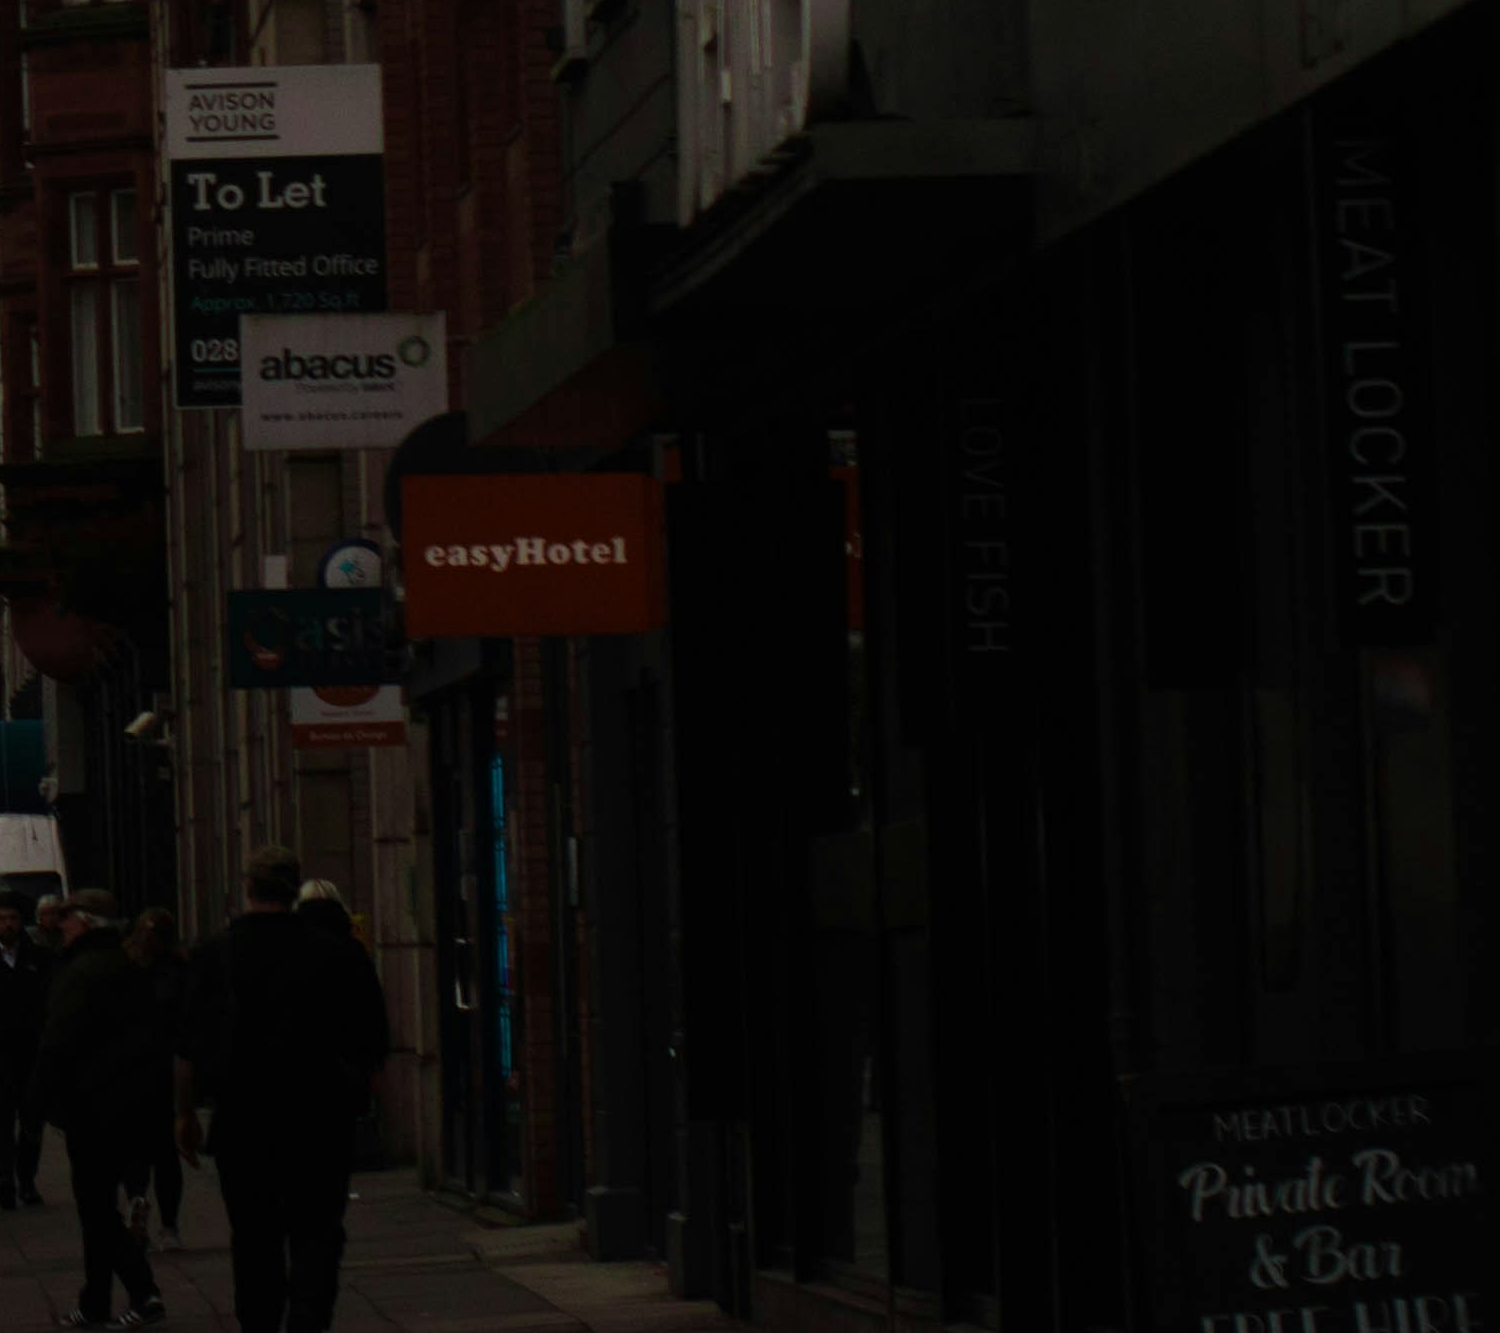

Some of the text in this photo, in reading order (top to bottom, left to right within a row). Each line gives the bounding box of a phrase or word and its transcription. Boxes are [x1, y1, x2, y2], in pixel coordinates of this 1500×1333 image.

[189, 93, 275, 111] AVISON
[189, 113, 276, 131] YOUNG
[186, 170, 328, 211] To Let
[187, 226, 256, 247] Prime
[187, 253, 380, 284] Fully Fitted Office
[259, 348, 396, 380] abacus
[1332, 136, 1414, 607] MEAT LOCKER
[959, 396, 1012, 654] LOVE FISH
[423, 535, 630, 574] easyHotel
[1177, 1145, 1483, 1222] Private Room
[1249, 1222, 1406, 1290] & Bar
